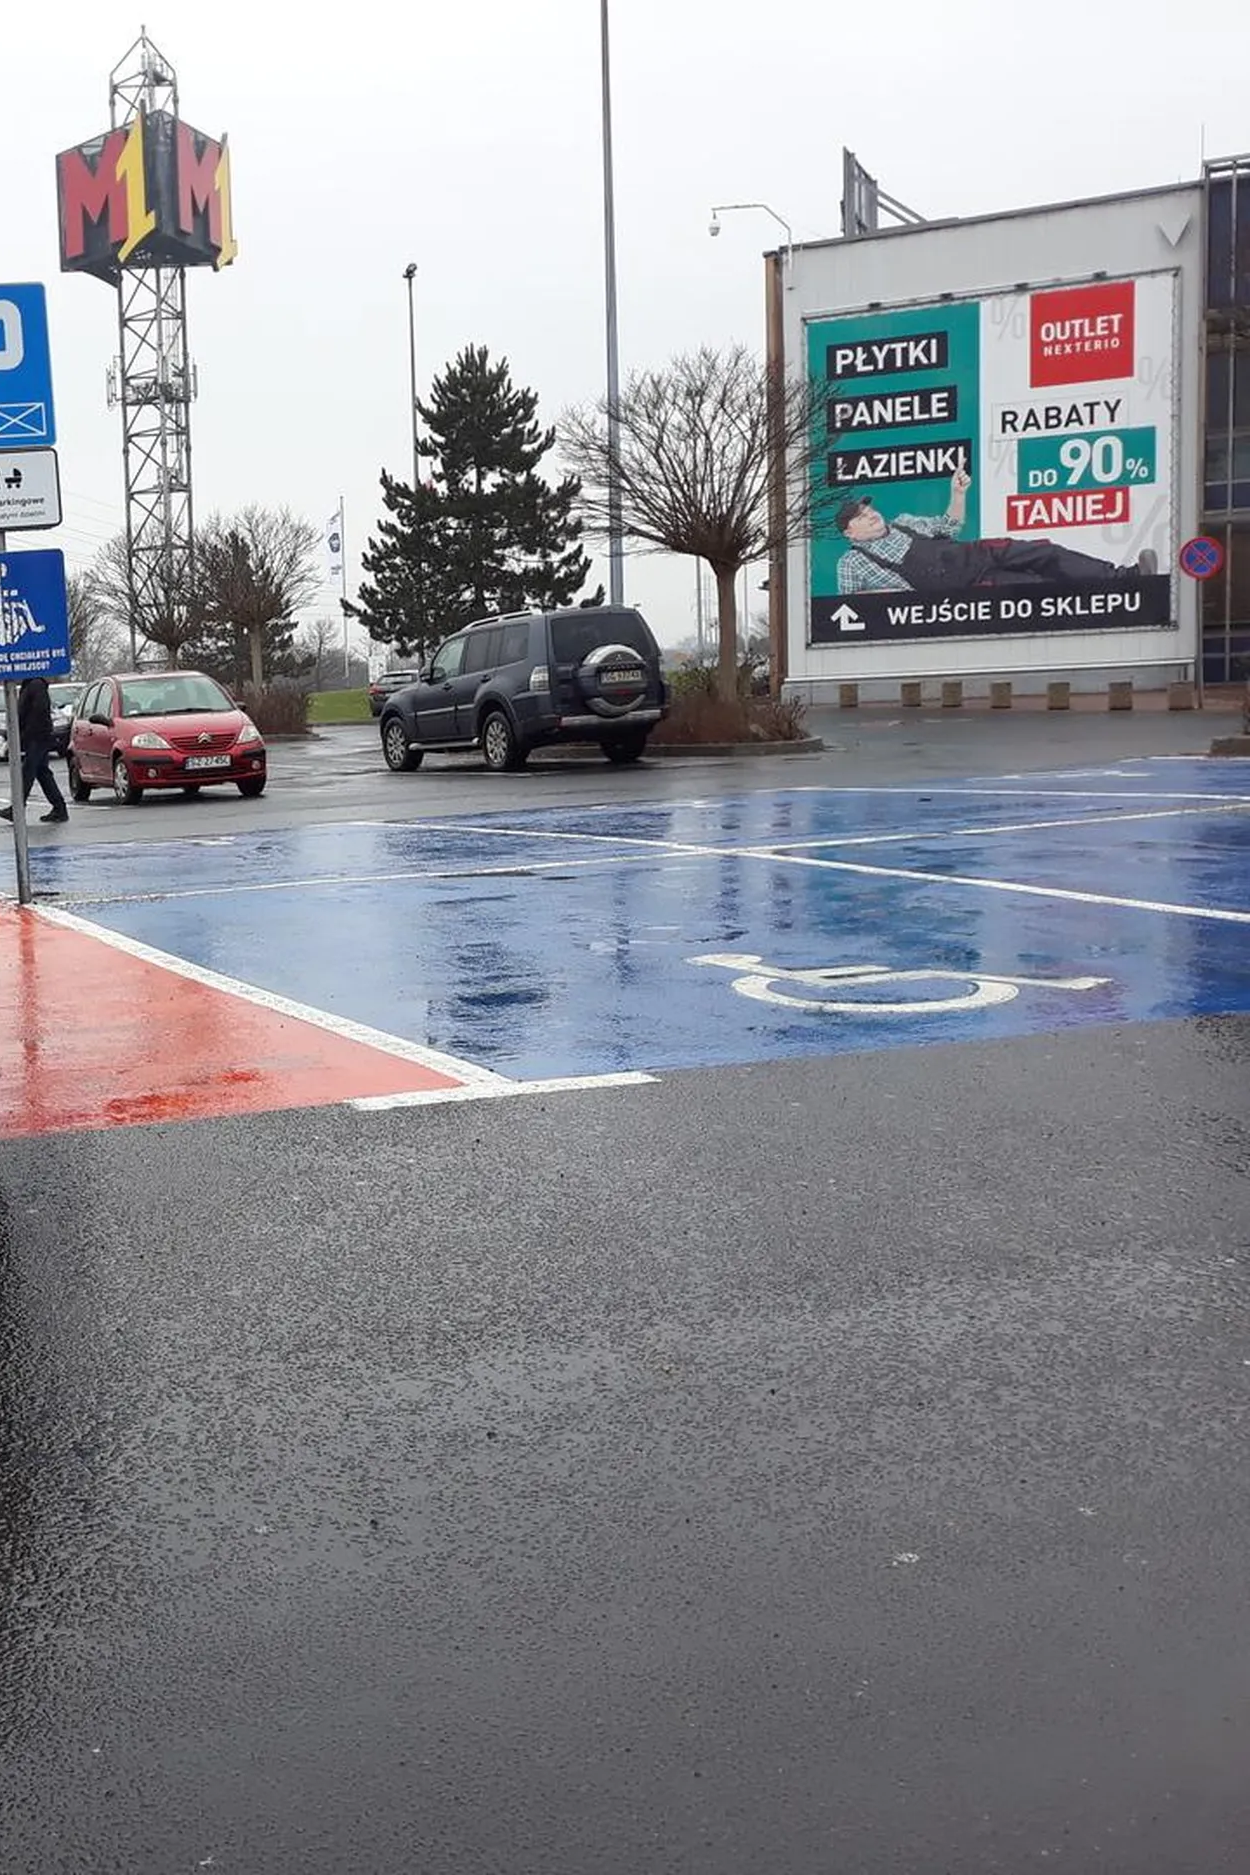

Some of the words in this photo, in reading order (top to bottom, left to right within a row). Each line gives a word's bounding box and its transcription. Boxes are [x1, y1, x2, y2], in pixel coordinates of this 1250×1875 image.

[61, 111, 156, 263] M1
[177, 120, 238, 269] M1
[1040, 313, 1123, 342] OUTLET
[835, 338, 938, 375] PŁYTKI
[1043, 338, 1120, 357] NEXTERIO
[834, 391, 949, 428] PANELE
[1000, 399, 1122, 434] RABATY
[835, 445, 967, 481] ŁAZIENKI
[1028, 468, 1058, 488] DO
[1010, 491, 1124, 527] TANIEJ
[887, 598, 991, 625] WEJŚCIE
[1000, 599, 1032, 620] DO
[1040, 592, 1141, 617] SKLEPU
